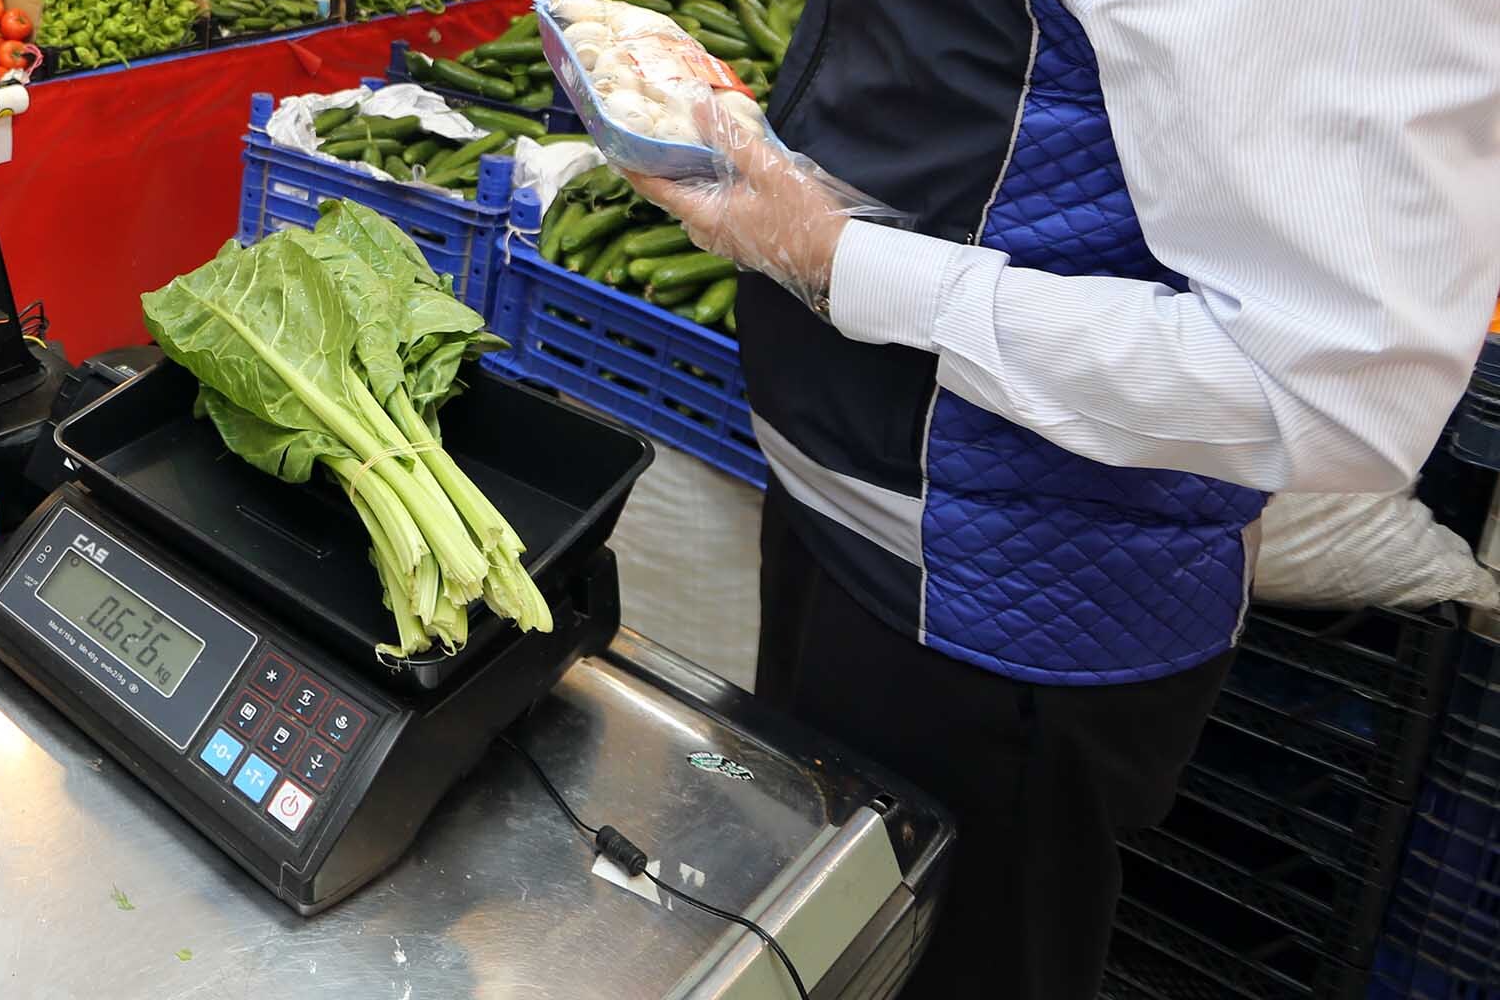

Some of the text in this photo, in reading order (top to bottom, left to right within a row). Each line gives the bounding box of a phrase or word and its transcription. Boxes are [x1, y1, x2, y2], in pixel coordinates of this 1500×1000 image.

[72, 534, 109, 564] CAS
[87, 596, 172, 686] 0.626 kg
